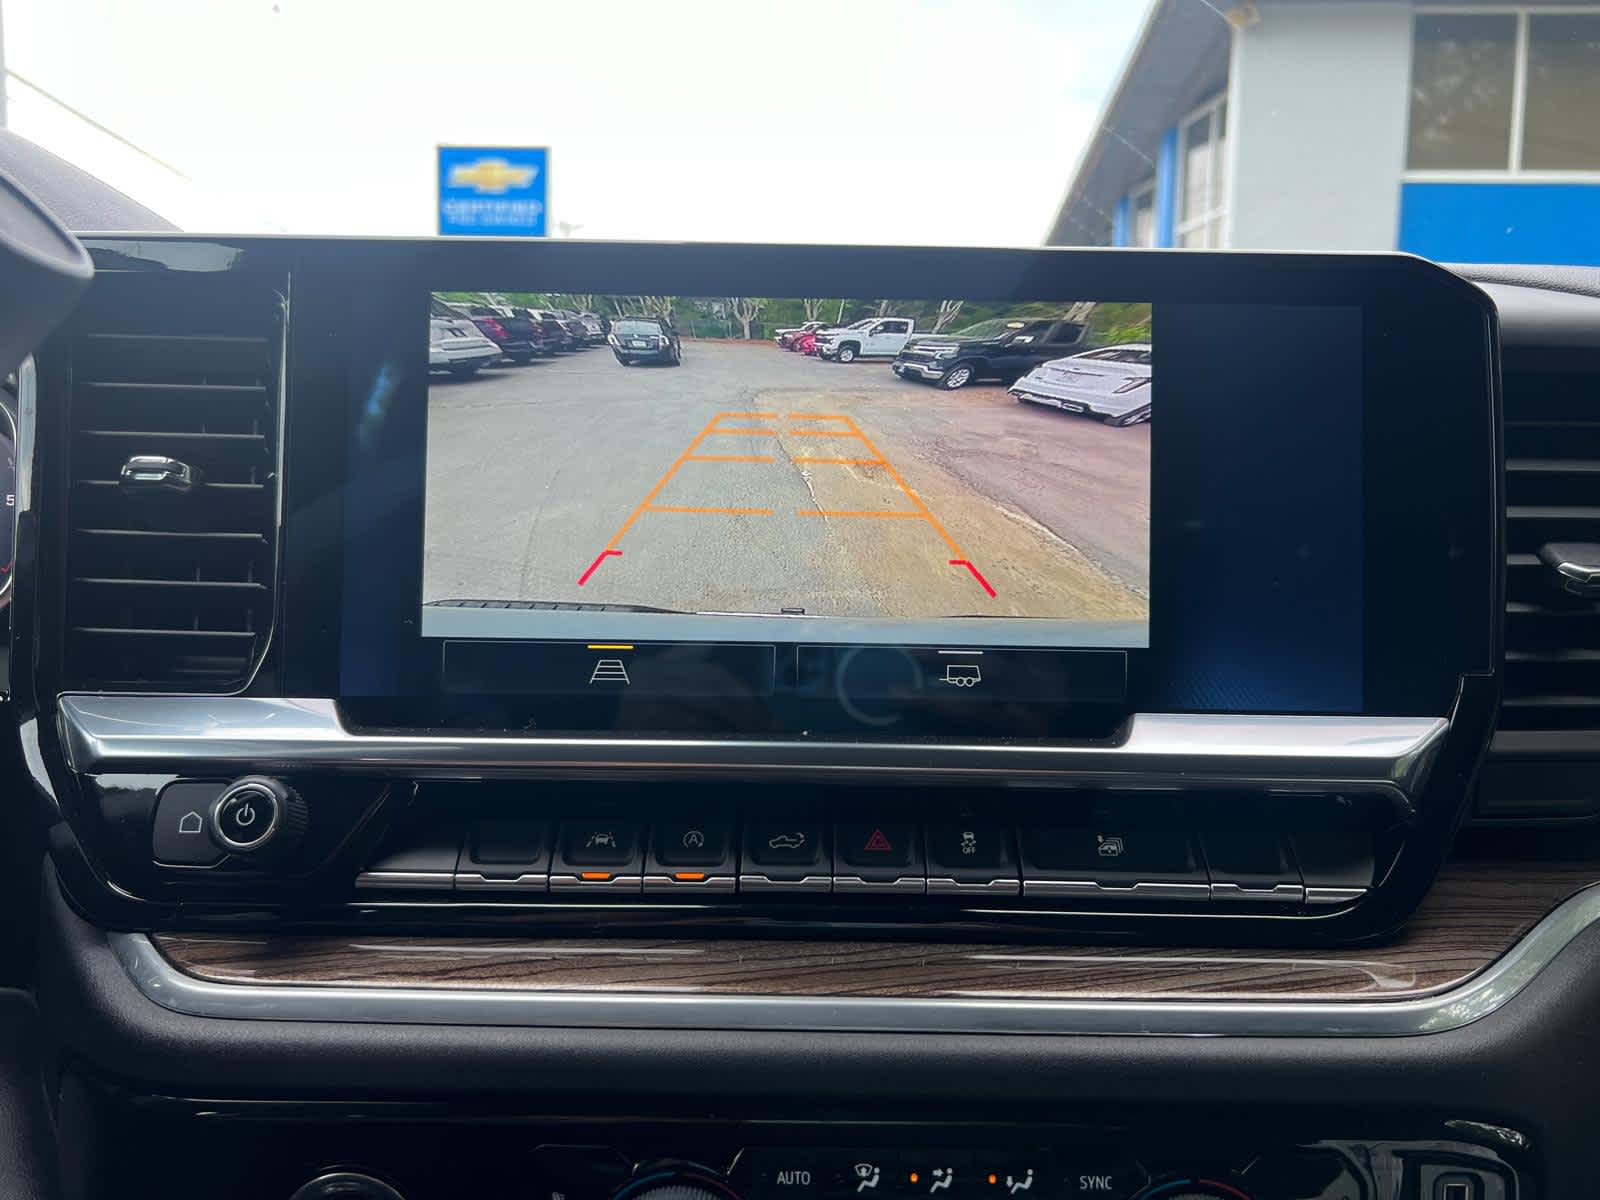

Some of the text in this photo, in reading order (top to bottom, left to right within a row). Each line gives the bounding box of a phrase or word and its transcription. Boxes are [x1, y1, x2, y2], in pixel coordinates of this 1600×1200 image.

[962, 846, 977, 855] OFF
[776, 1170, 811, 1185] AUTO
[1079, 1175, 1113, 1190] SYNC
